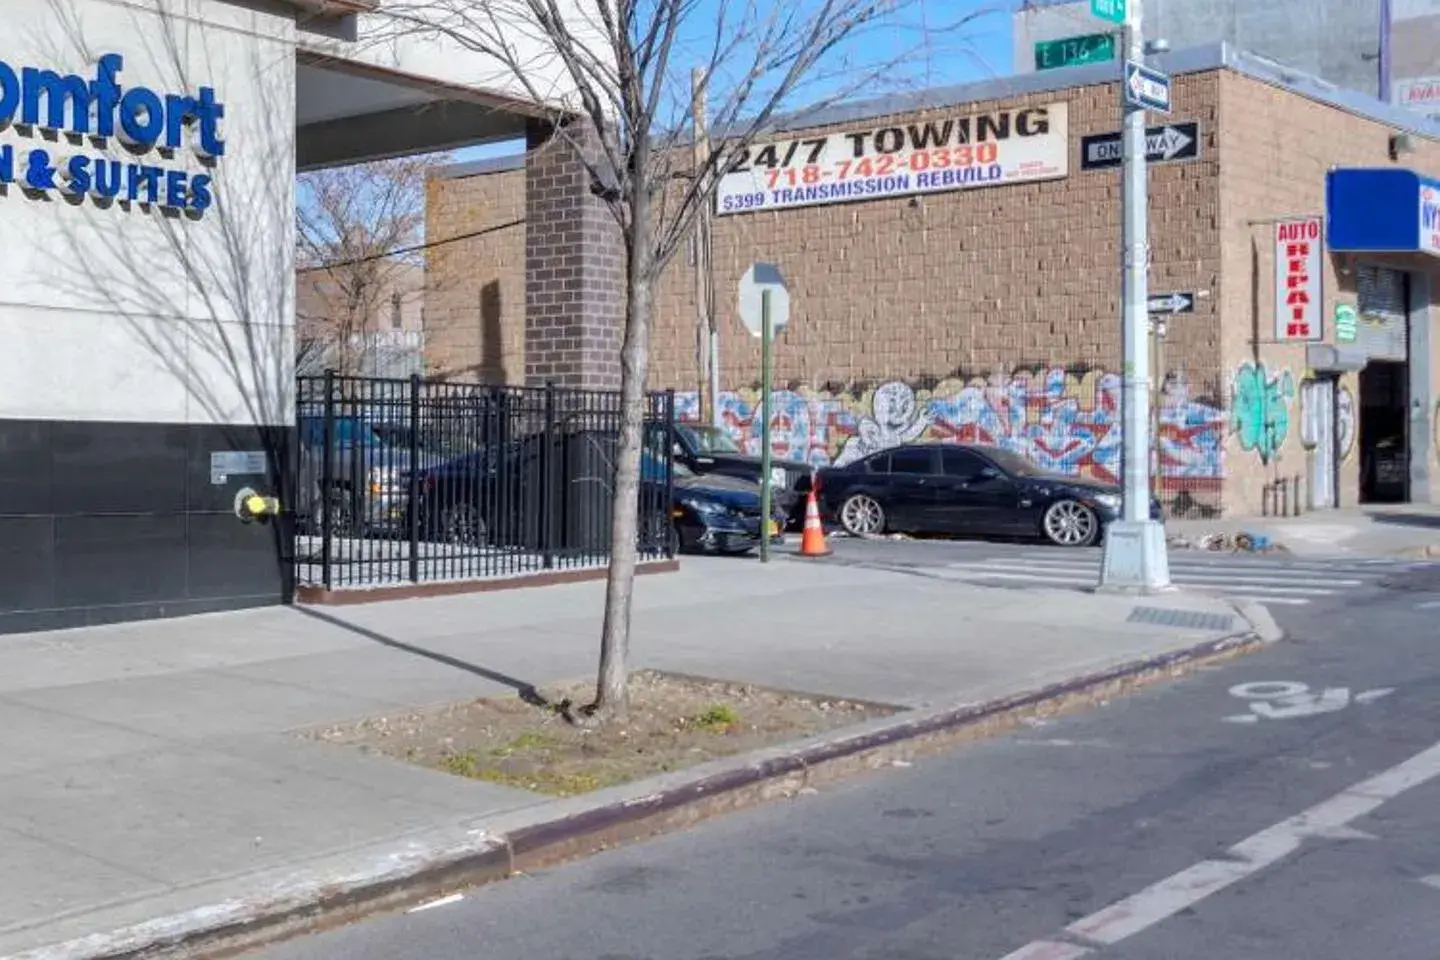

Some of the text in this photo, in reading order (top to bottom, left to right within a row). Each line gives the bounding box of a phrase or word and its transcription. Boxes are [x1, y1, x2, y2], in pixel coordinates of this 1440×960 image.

[1042, 44, 1052, 67] E
[1061, 37, 1091, 64] 136
[727, 107, 1050, 174] 24/7 TOWING
[1096, 132, 1178, 160] ON WAY
[26, 149, 59, 190] &
[67, 154, 212, 212] SUITES
[764, 142, 998, 190] 718-742-0330
[772, 172, 910, 205] TRANSMISSION
[916, 163, 1003, 189] REBUILD
[1278, 220, 1319, 242] AUTO
[1285, 242, 1310, 337] REPAIR
